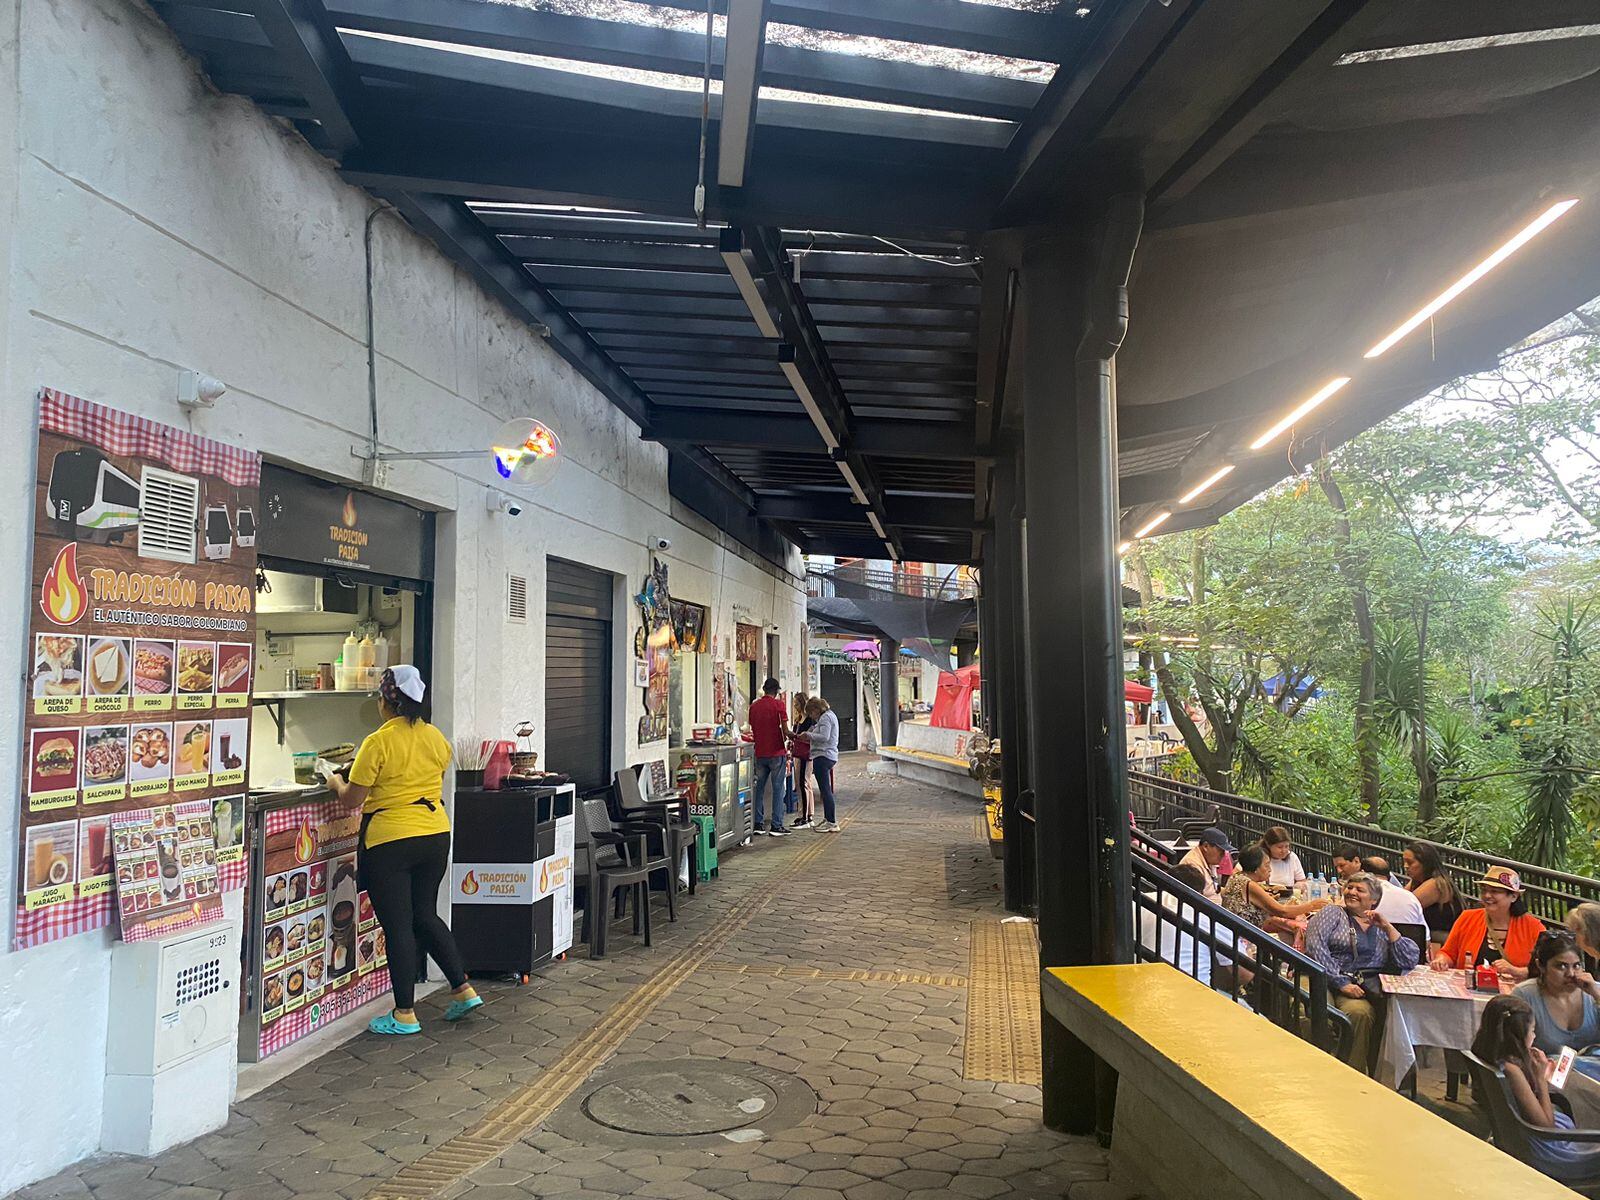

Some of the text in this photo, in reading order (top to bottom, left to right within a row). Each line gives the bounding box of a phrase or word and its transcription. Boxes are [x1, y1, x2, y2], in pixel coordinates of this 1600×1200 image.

[329, 525, 368, 546] TRADICIÓN
[338, 544, 359, 561] PAISA
[91, 568, 251, 614] TRADICIÓN PAISA
[94, 607, 247, 631] EL AUTÉNTICO SABOR COLOMBIANO
[43, 698, 61, 706] AREPA
[113, 696, 121, 704] DE
[47, 704, 69, 713] QUESO
[188, 777, 207, 785] MANGO
[132, 782, 167, 793] ABORRAJADO
[87, 788, 121, 799] SALCHIPAPA
[31, 795, 76, 806] HAMBURGUESA
[217, 854, 237, 863] NATURAL
[478, 871, 527, 883] TRADICIÓN
[84, 882, 100, 892] JUGO
[490, 884, 515, 894] PAISA
[42, 888, 58, 898] JUGO
[33, 894, 66, 907] MARACUYÁ
[320, 999, 336, 1016] 305
